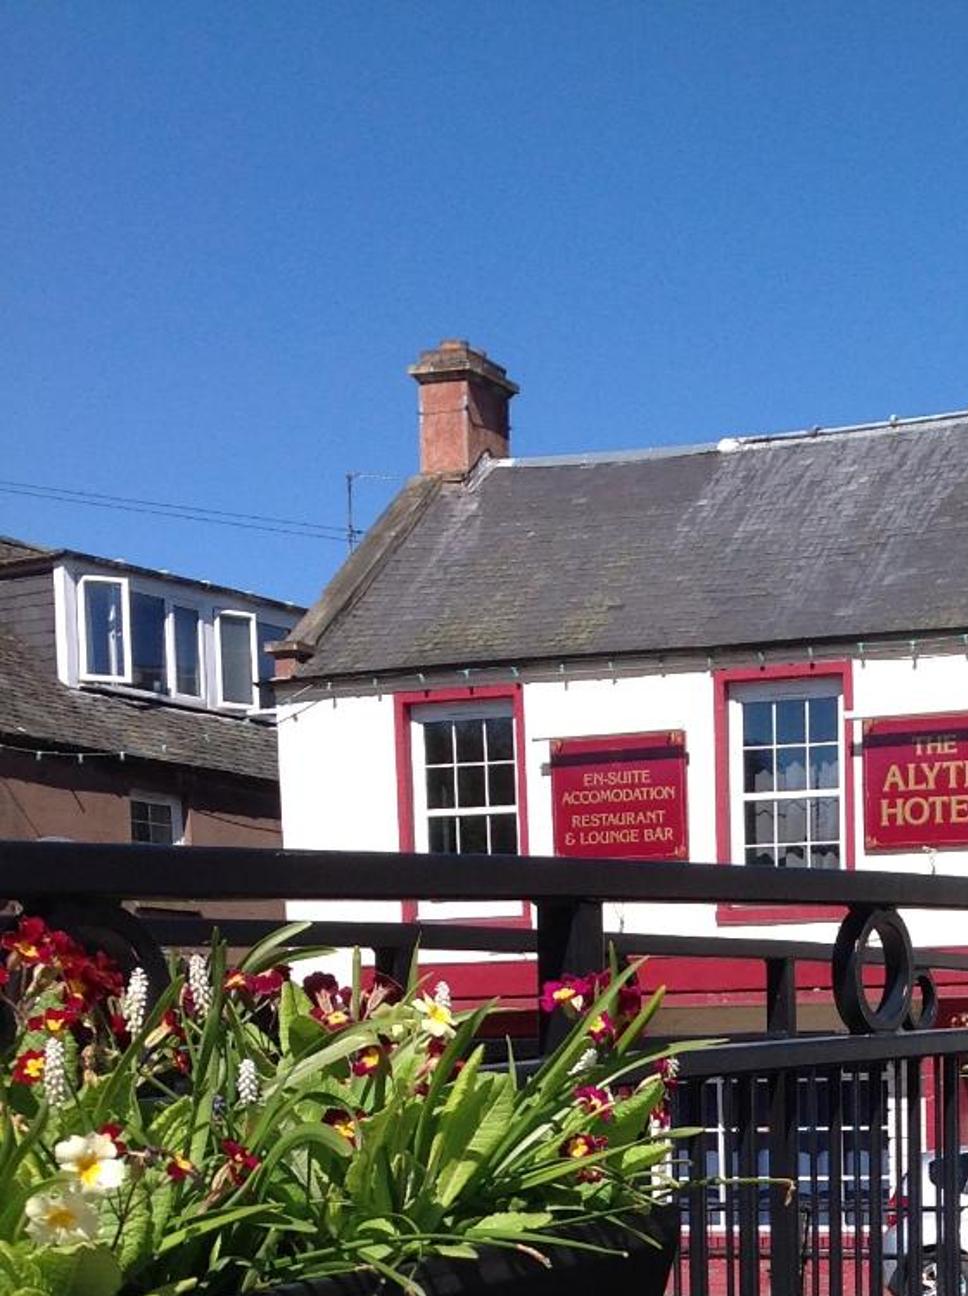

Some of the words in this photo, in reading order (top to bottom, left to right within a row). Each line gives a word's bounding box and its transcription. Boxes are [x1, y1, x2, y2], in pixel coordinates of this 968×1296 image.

[914, 735, 957, 756] THE
[583, 770, 650, 786] EN-SUITE
[562, 786, 675, 805] ACCOMODATION
[571, 810, 666, 828] RESTAURANT
[565, 833, 576, 846] &
[581, 829, 638, 845] LOUNGE
[644, 827, 673, 842] BAR
